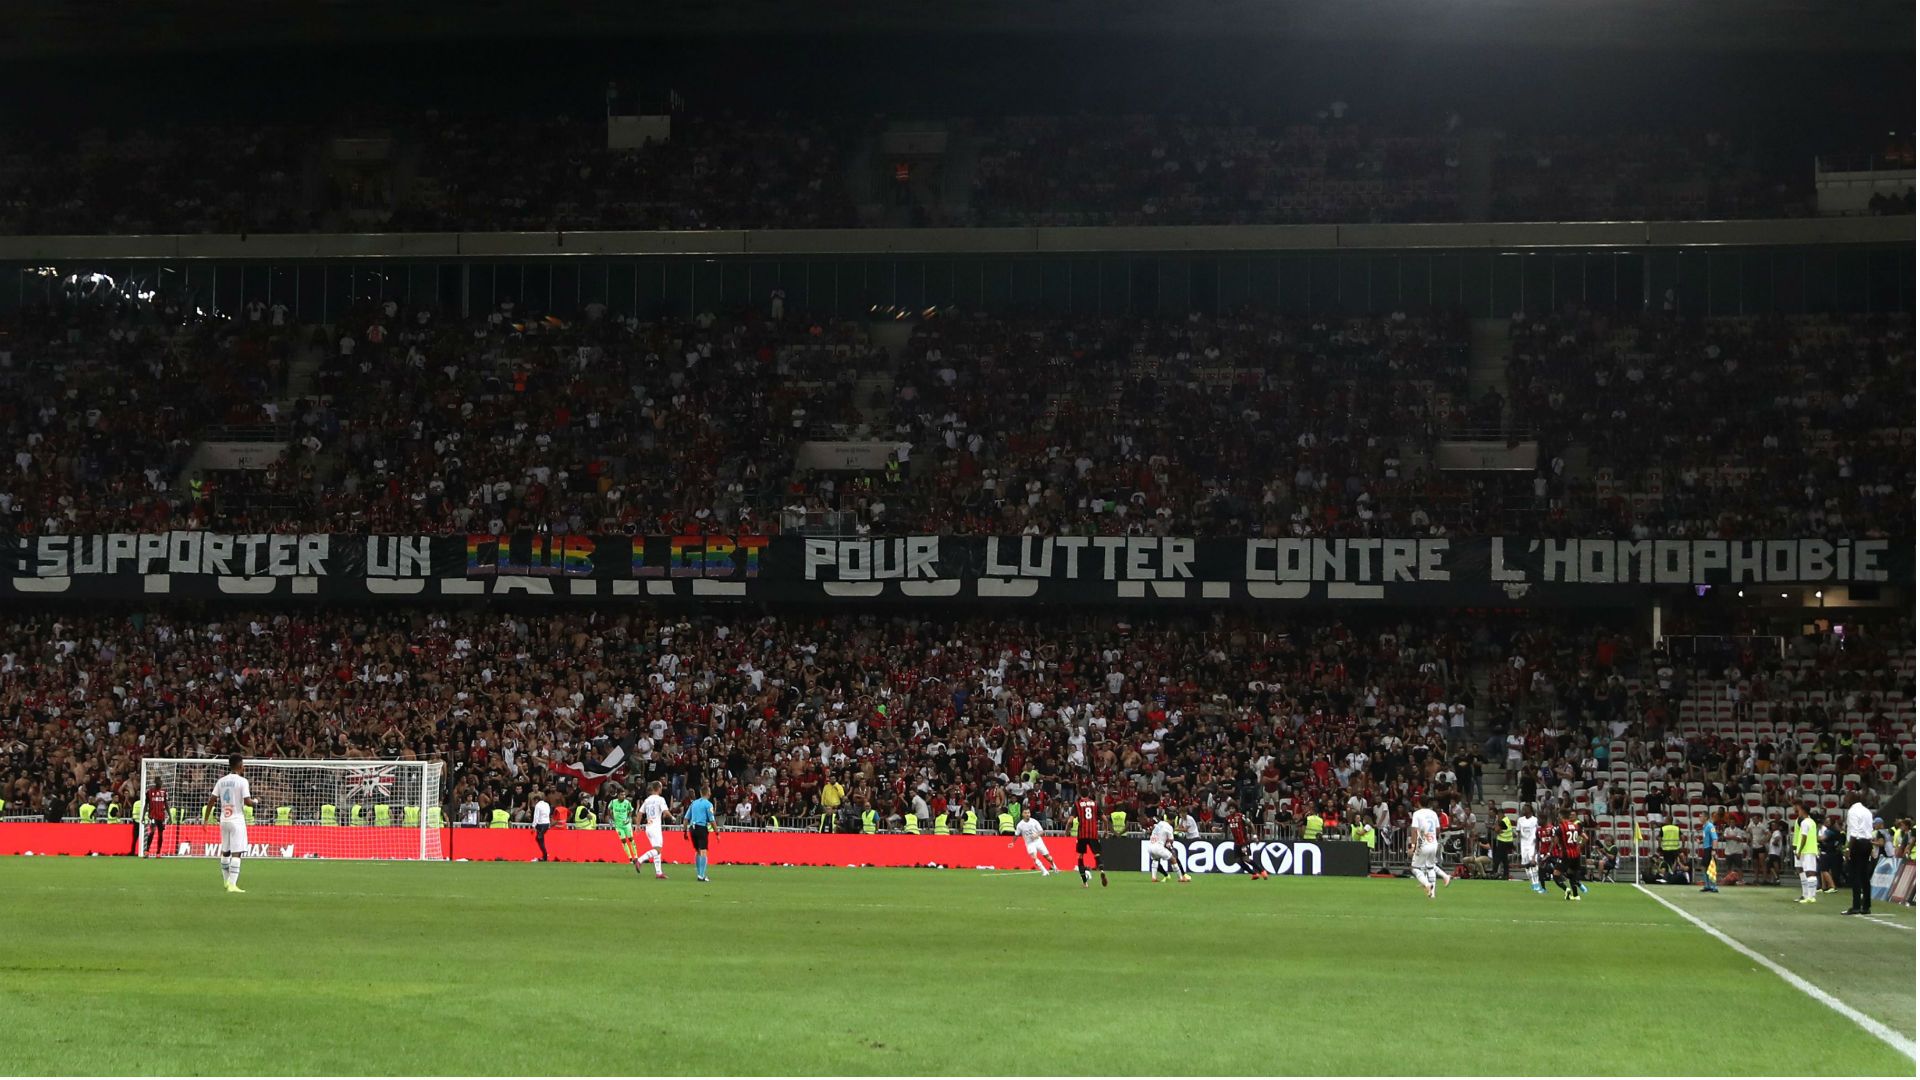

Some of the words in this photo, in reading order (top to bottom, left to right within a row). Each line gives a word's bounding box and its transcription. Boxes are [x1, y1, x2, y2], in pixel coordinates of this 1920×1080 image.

[366, 535, 431, 577] UN
[466, 534, 596, 576] CLUB
[632, 534, 769, 577] LGBT
[805, 535, 940, 580] POUR
[986, 535, 1196, 580] LUTTER
[1246, 537, 1451, 583] CONTRE
[1085, 807, 1093, 820] 8
[1427, 819, 1434, 833] 2
[1566, 830, 1578, 844] 20
[204, 843, 270, 857] WIMAX
